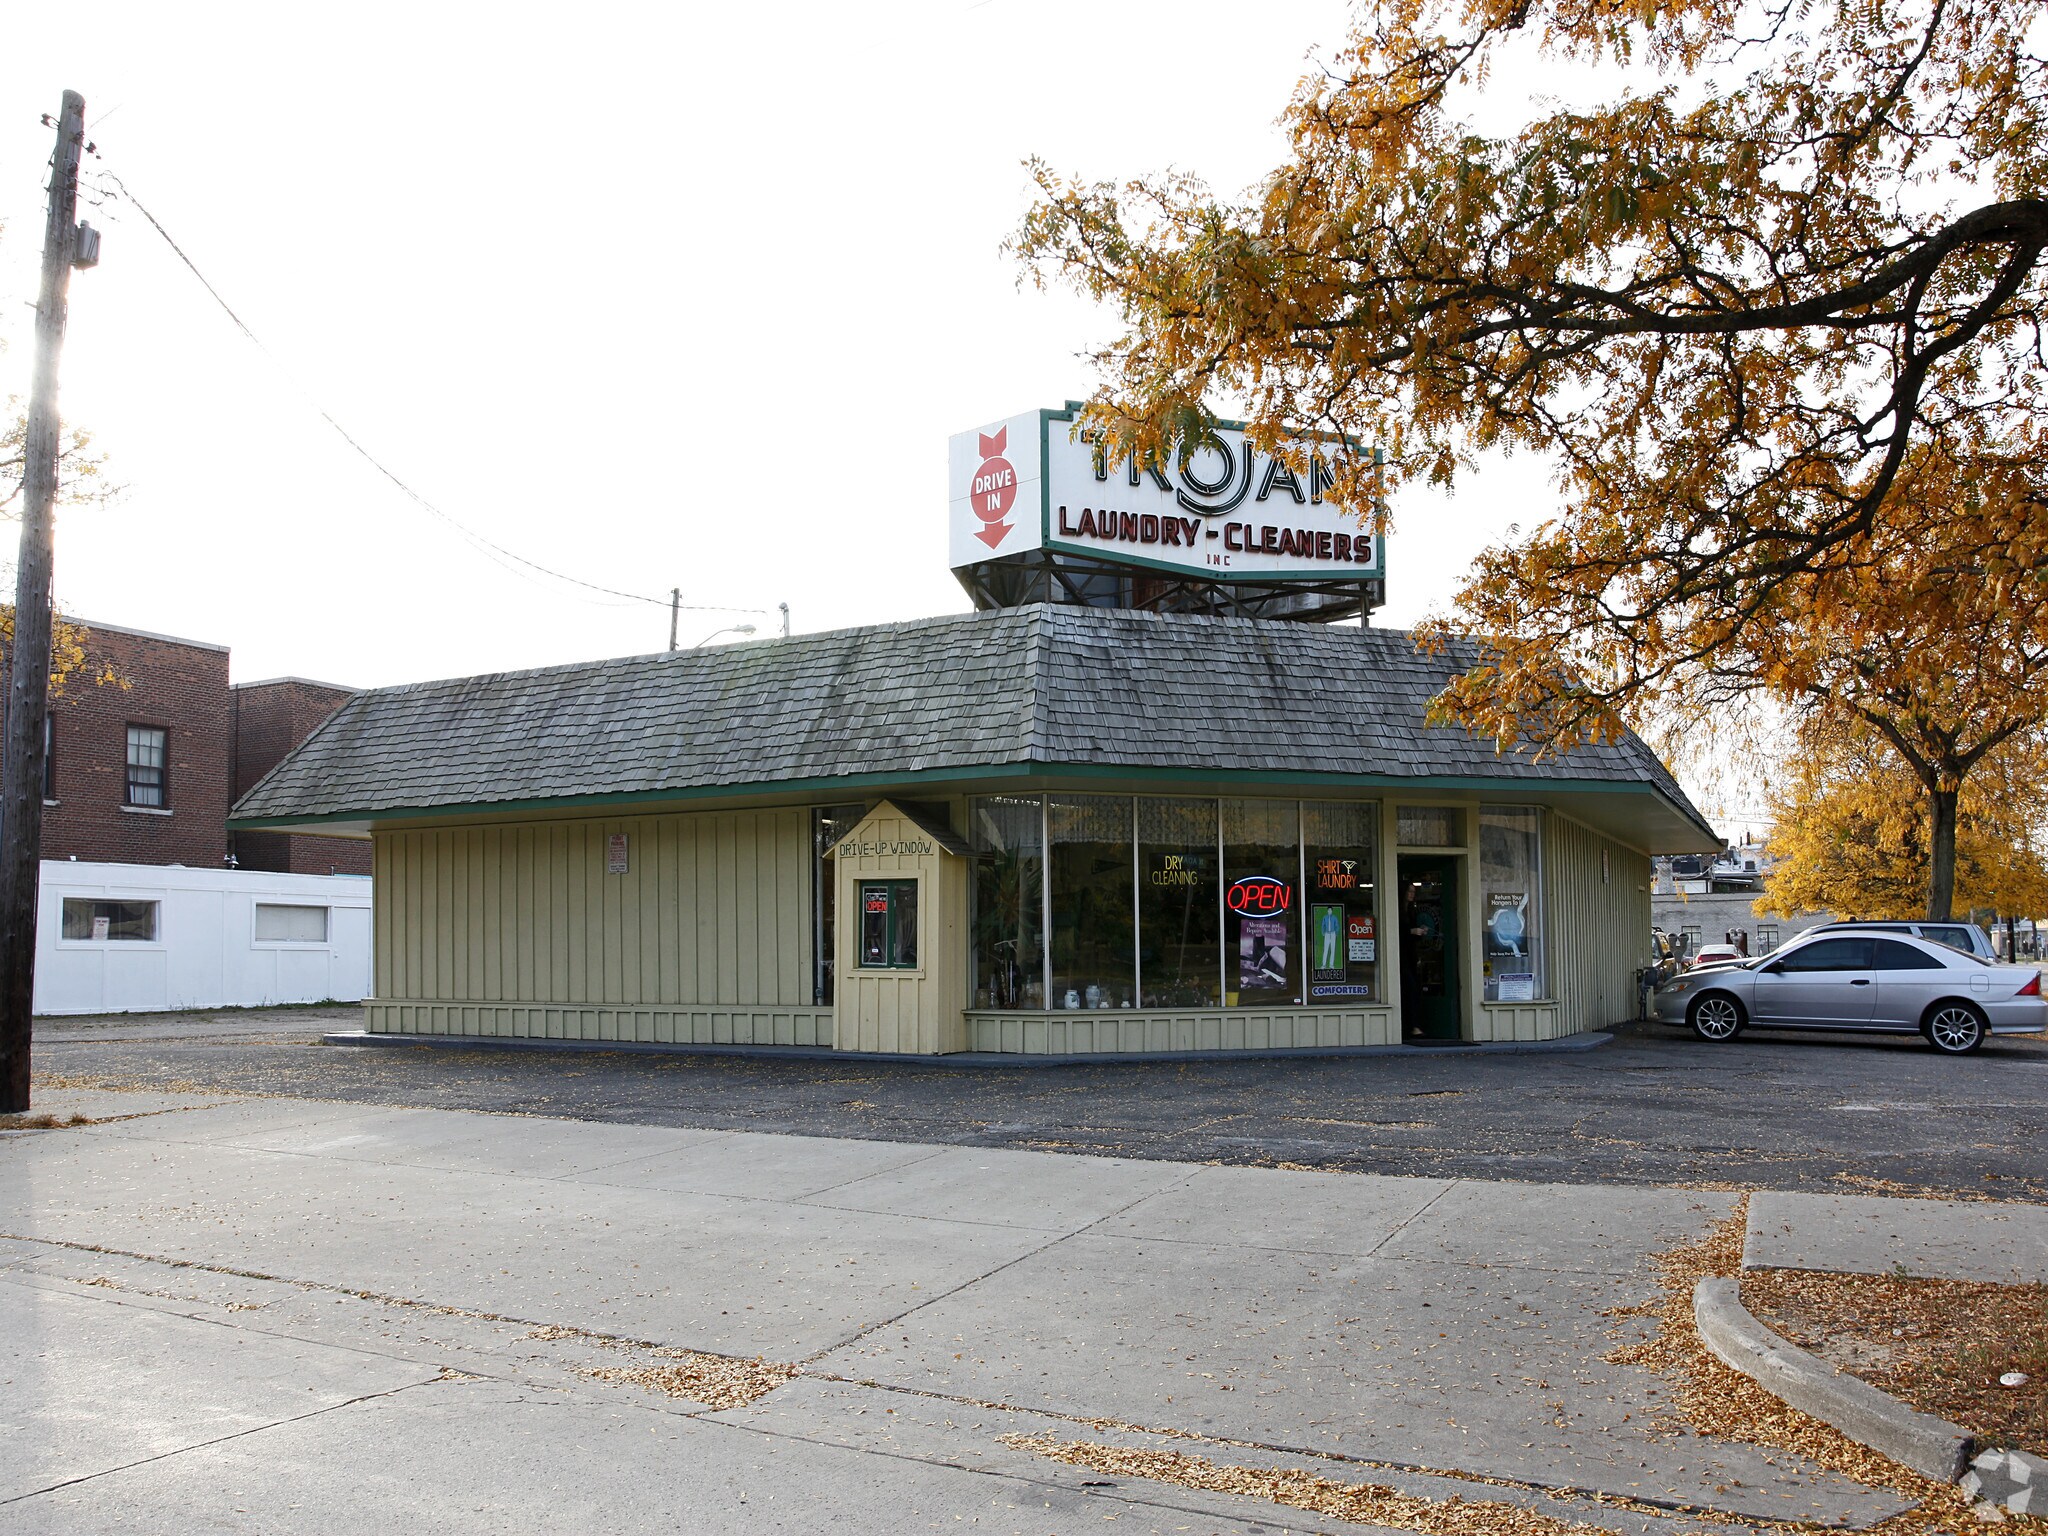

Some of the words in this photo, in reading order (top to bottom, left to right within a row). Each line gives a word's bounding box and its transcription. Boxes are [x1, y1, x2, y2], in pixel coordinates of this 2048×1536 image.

[1081, 428, 1350, 516] TROJAN
[975, 468, 1012, 495] DRIVE
[987, 491, 1001, 512] IN
[1058, 505, 1202, 547] LAUNDRY
[1224, 522, 1372, 563] CLEANERS
[1206, 553, 1231, 566] INC
[840, 842, 888, 856] DRIVE-UP
[890, 841, 932, 855] WINDOW
[1164, 855, 1184, 871] DRY
[1317, 859, 1341, 874] SHIRT
[1151, 870, 1198, 886] CLEANING
[1317, 874, 1358, 889] LAUNDRY
[1226, 884, 1291, 909] OPEN
[867, 901, 887, 911] OPEN
[1349, 923, 1373, 936] Open
[1314, 970, 1344, 980] LAUNDERED
[1312, 986, 1368, 995] COMFORTERS
